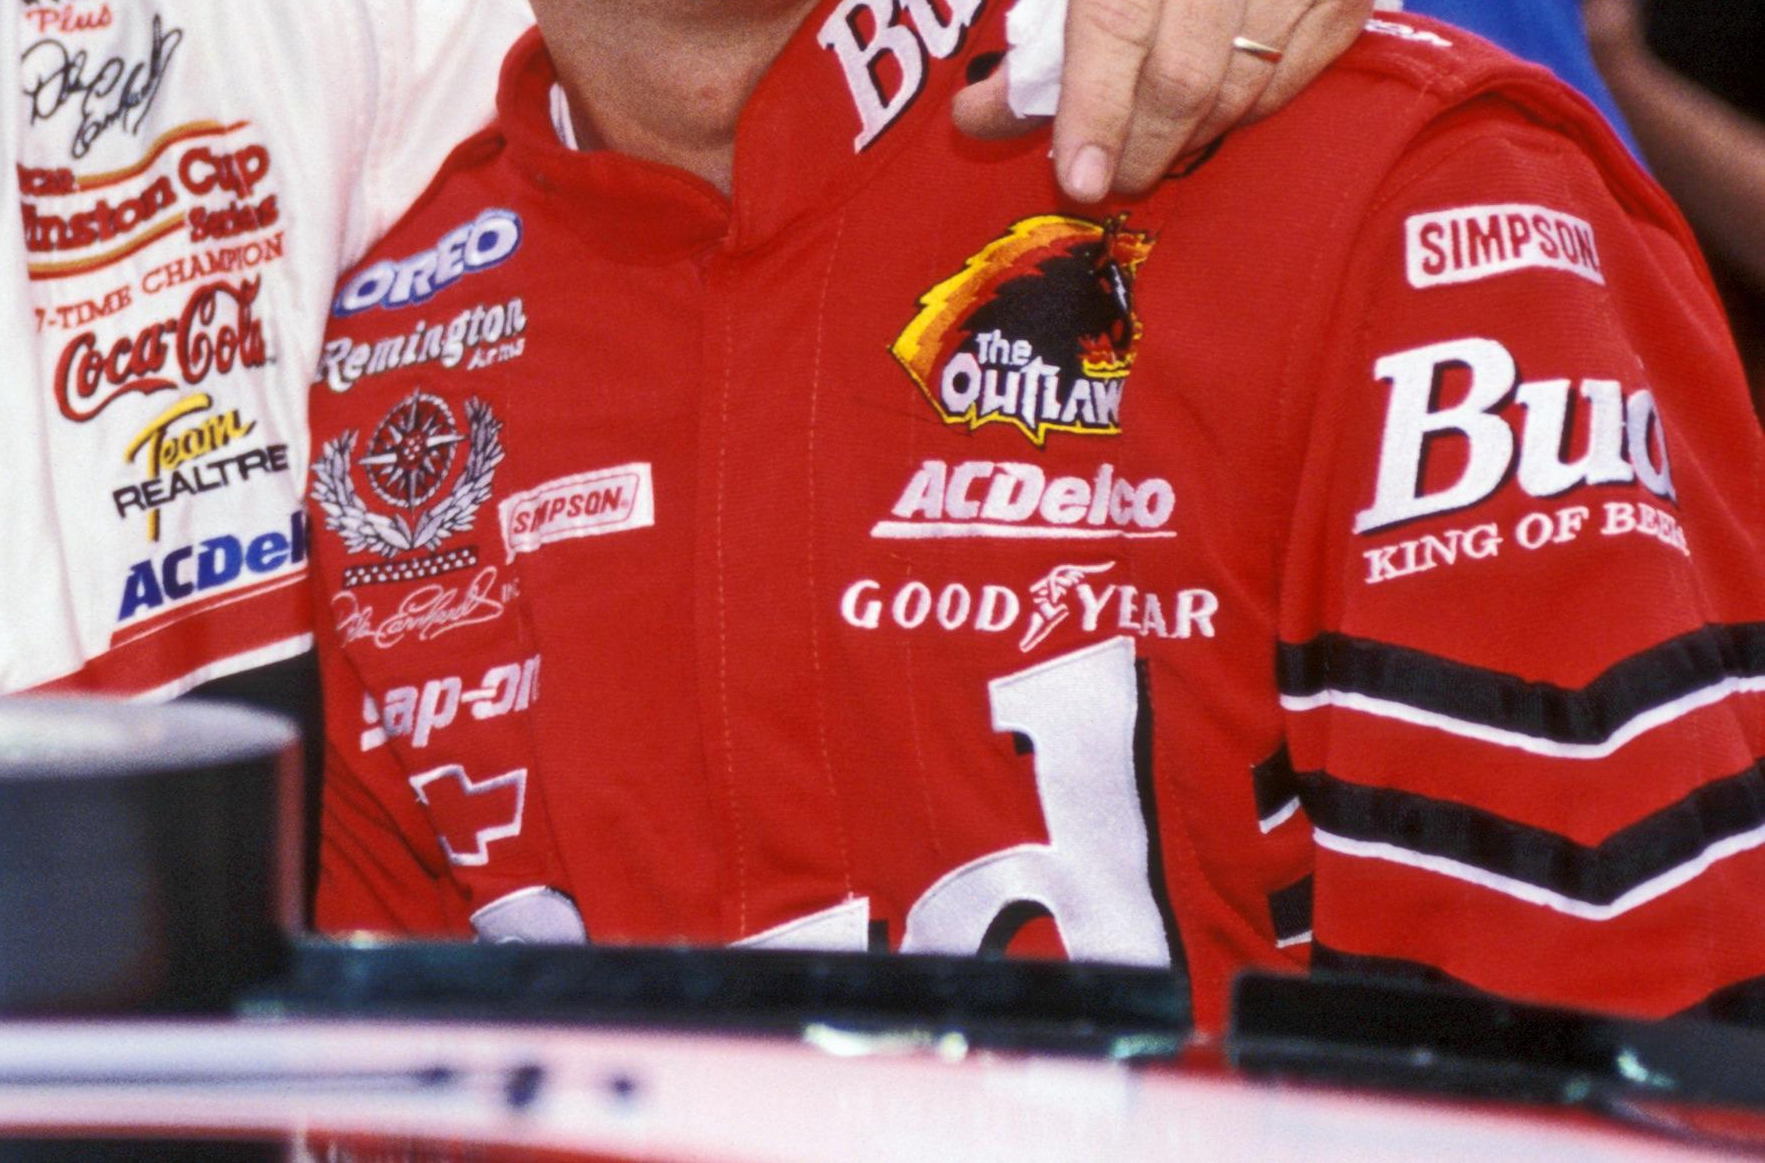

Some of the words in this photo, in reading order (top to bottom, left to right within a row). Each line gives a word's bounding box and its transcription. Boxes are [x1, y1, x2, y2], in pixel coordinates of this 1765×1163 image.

[26, 4, 113, 33] Plus
[178, 144, 270, 199] Cup
[336, 211, 521, 315] OREO
[1419, 213, 1599, 277] SIMPSON
[54, 273, 268, 423] Coca-Cola
[317, 298, 527, 393] Remington
[468, 338, 526, 371] Arms
[976, 329, 1033, 366] The
[112, 443, 289, 519] REALTRE
[123, 392, 257, 542] Team
[891, 460, 1176, 528] ACDelco
[118, 508, 308, 621] ACDel
[1363, 523, 1503, 584] KING
[1515, 506, 1589, 549] OF
